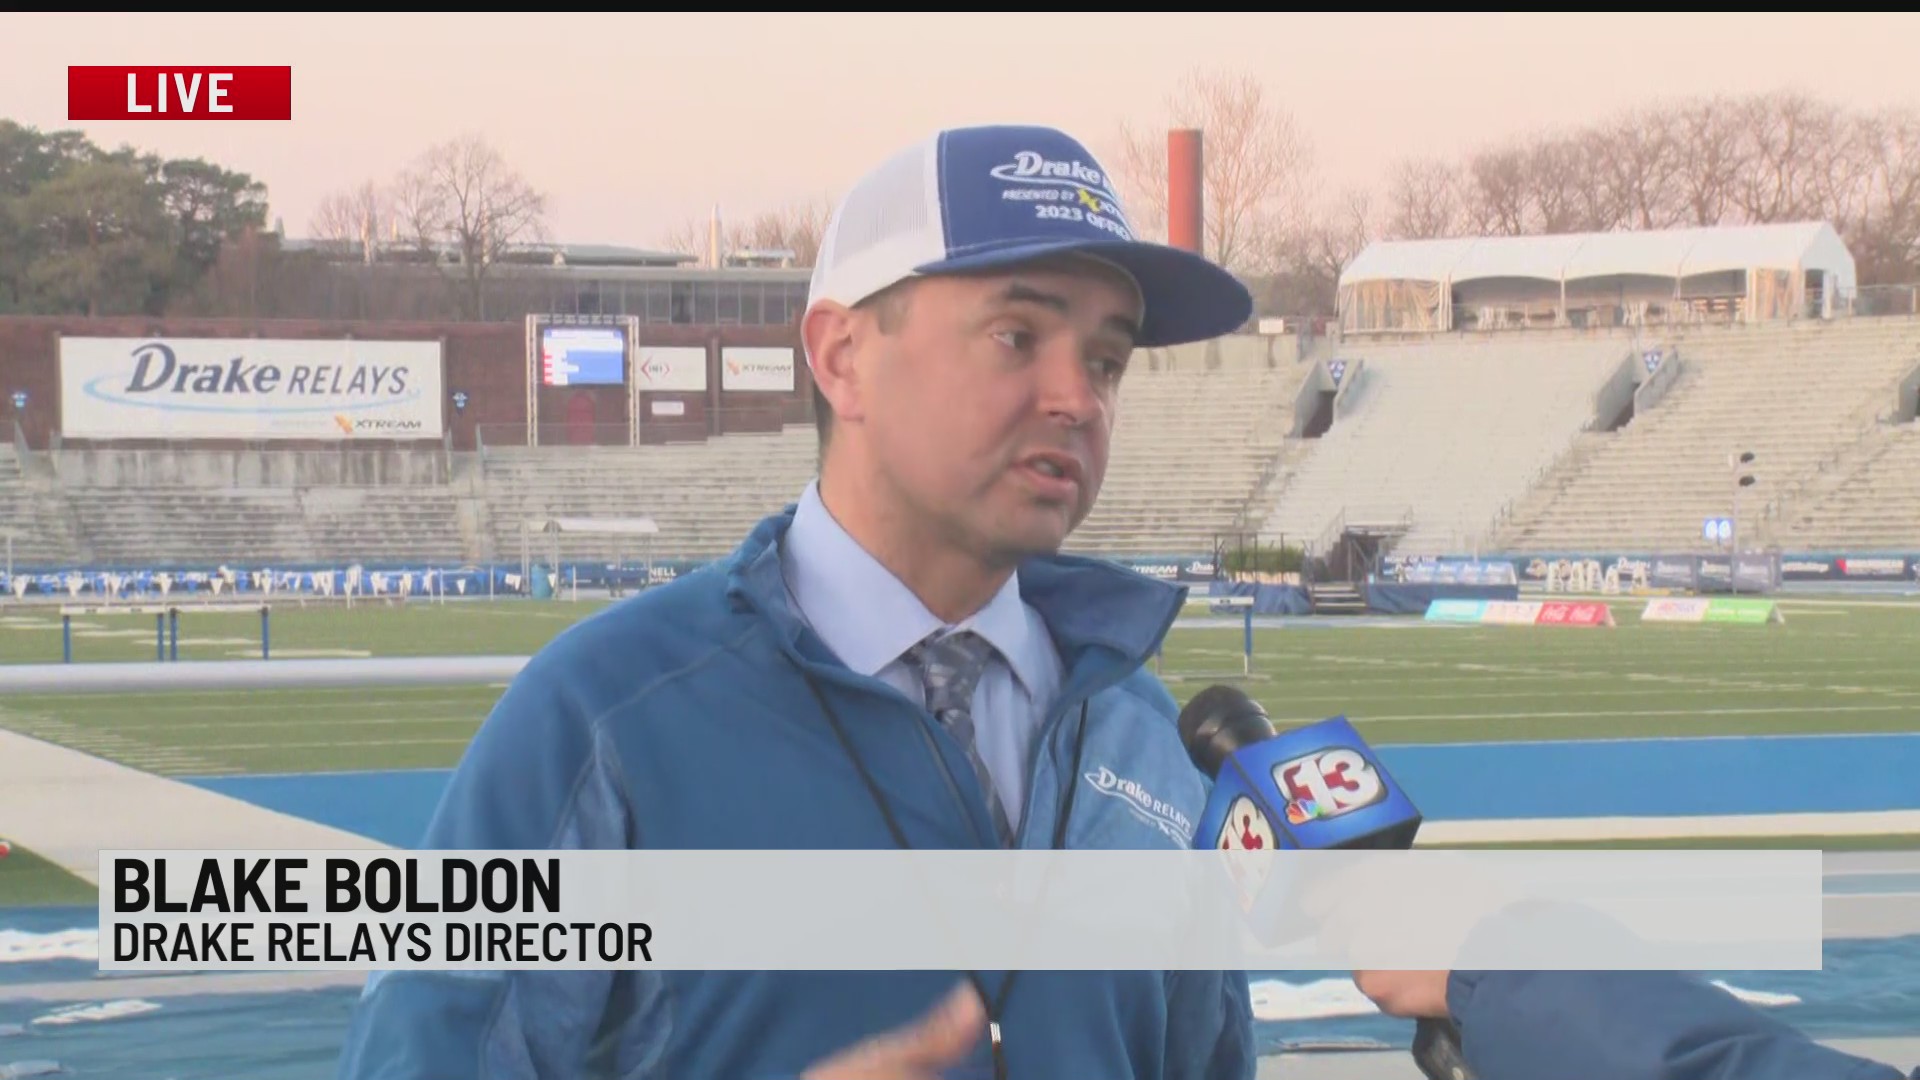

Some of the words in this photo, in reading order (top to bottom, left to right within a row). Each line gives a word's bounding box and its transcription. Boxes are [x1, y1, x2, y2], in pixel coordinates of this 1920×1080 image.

[1014, 151, 1101, 184] Drake
[1035, 205, 1083, 221] 2023
[124, 343, 281, 395] Drake
[288, 366, 410, 395] RELAYS
[354, 418, 422, 430] XTREAM
[1098, 766, 1152, 807] Drake
[1292, 749, 1380, 813] 13
